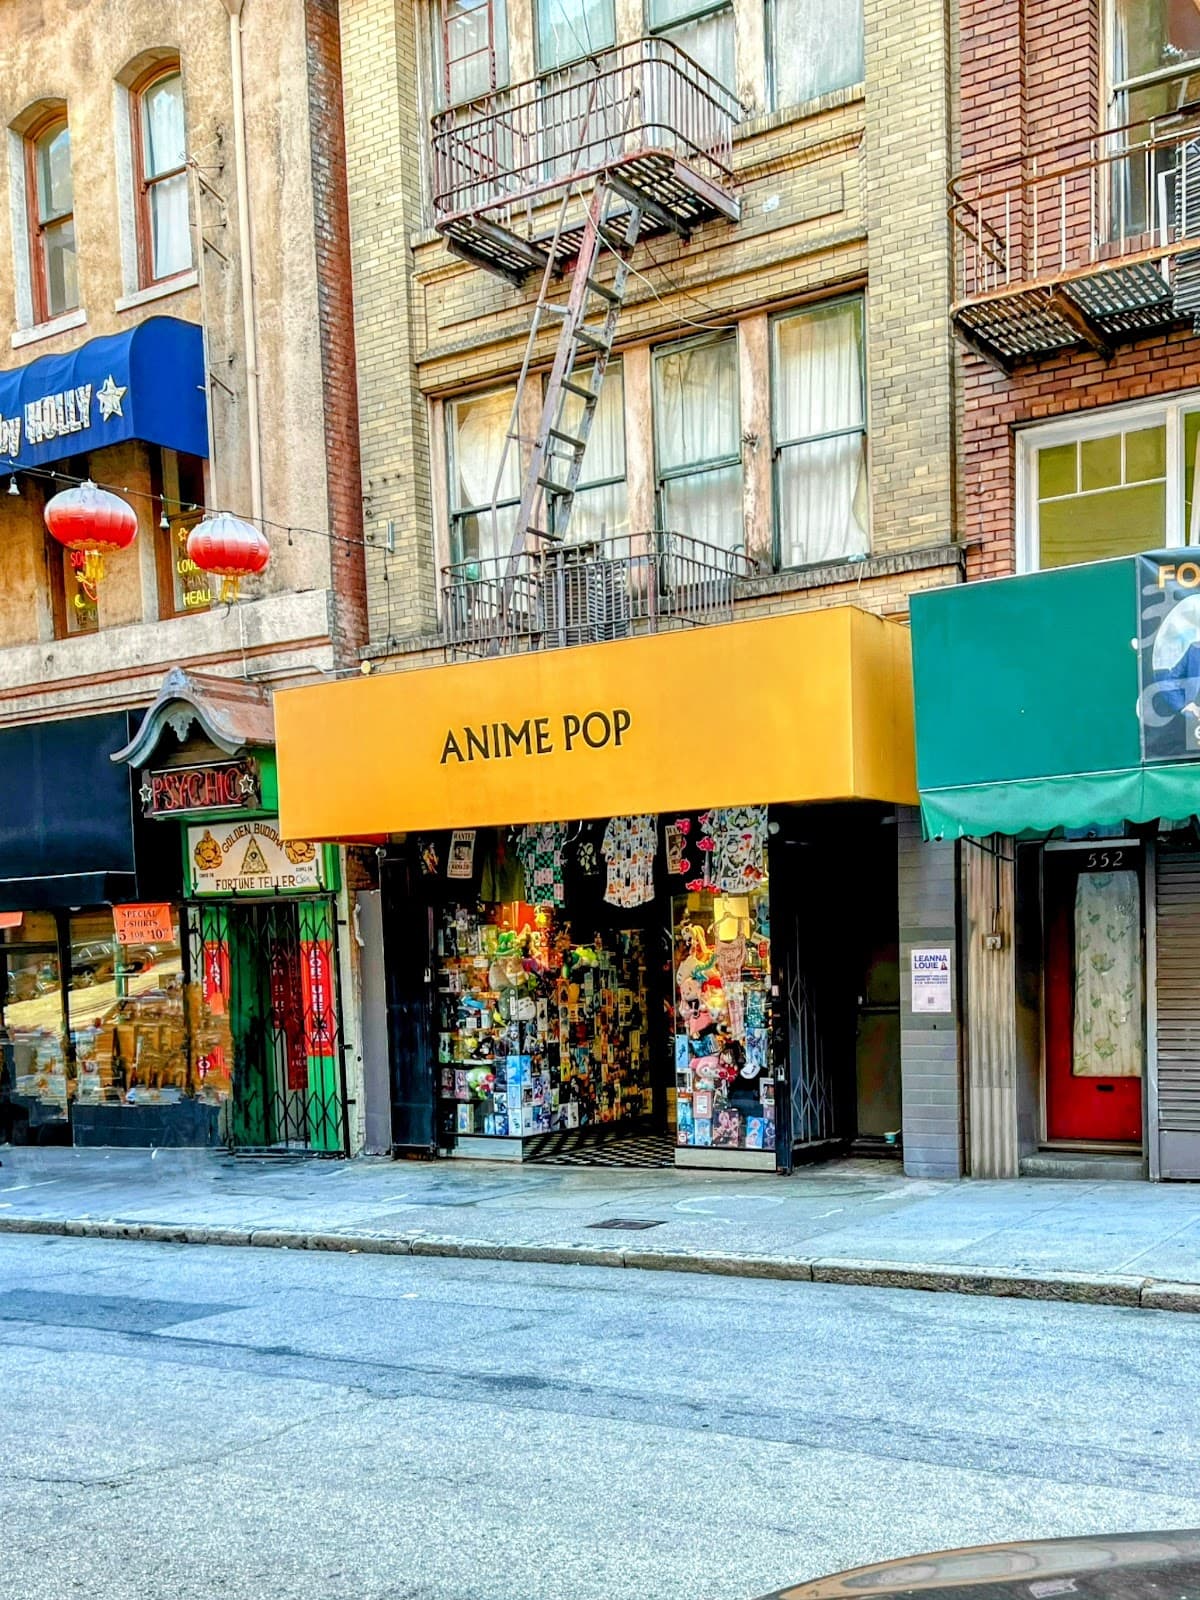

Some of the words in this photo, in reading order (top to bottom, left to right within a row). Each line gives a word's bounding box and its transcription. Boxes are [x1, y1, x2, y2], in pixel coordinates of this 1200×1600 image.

[439, 717, 553, 765] ANIME
[562, 708, 632, 752] POP
[152, 766, 244, 810] PSYCHIC
[221, 823, 252, 854] GOLDEN
[253, 822, 285, 852] BUDDHA
[1087, 851, 1123, 868] 552
[215, 877, 255, 891] FORTUNE
[257, 875, 296, 888] TELLER
[122, 910, 158, 919] SPECIAL
[119, 929, 127, 941] 5
[914, 954, 948, 962] LEANNA
